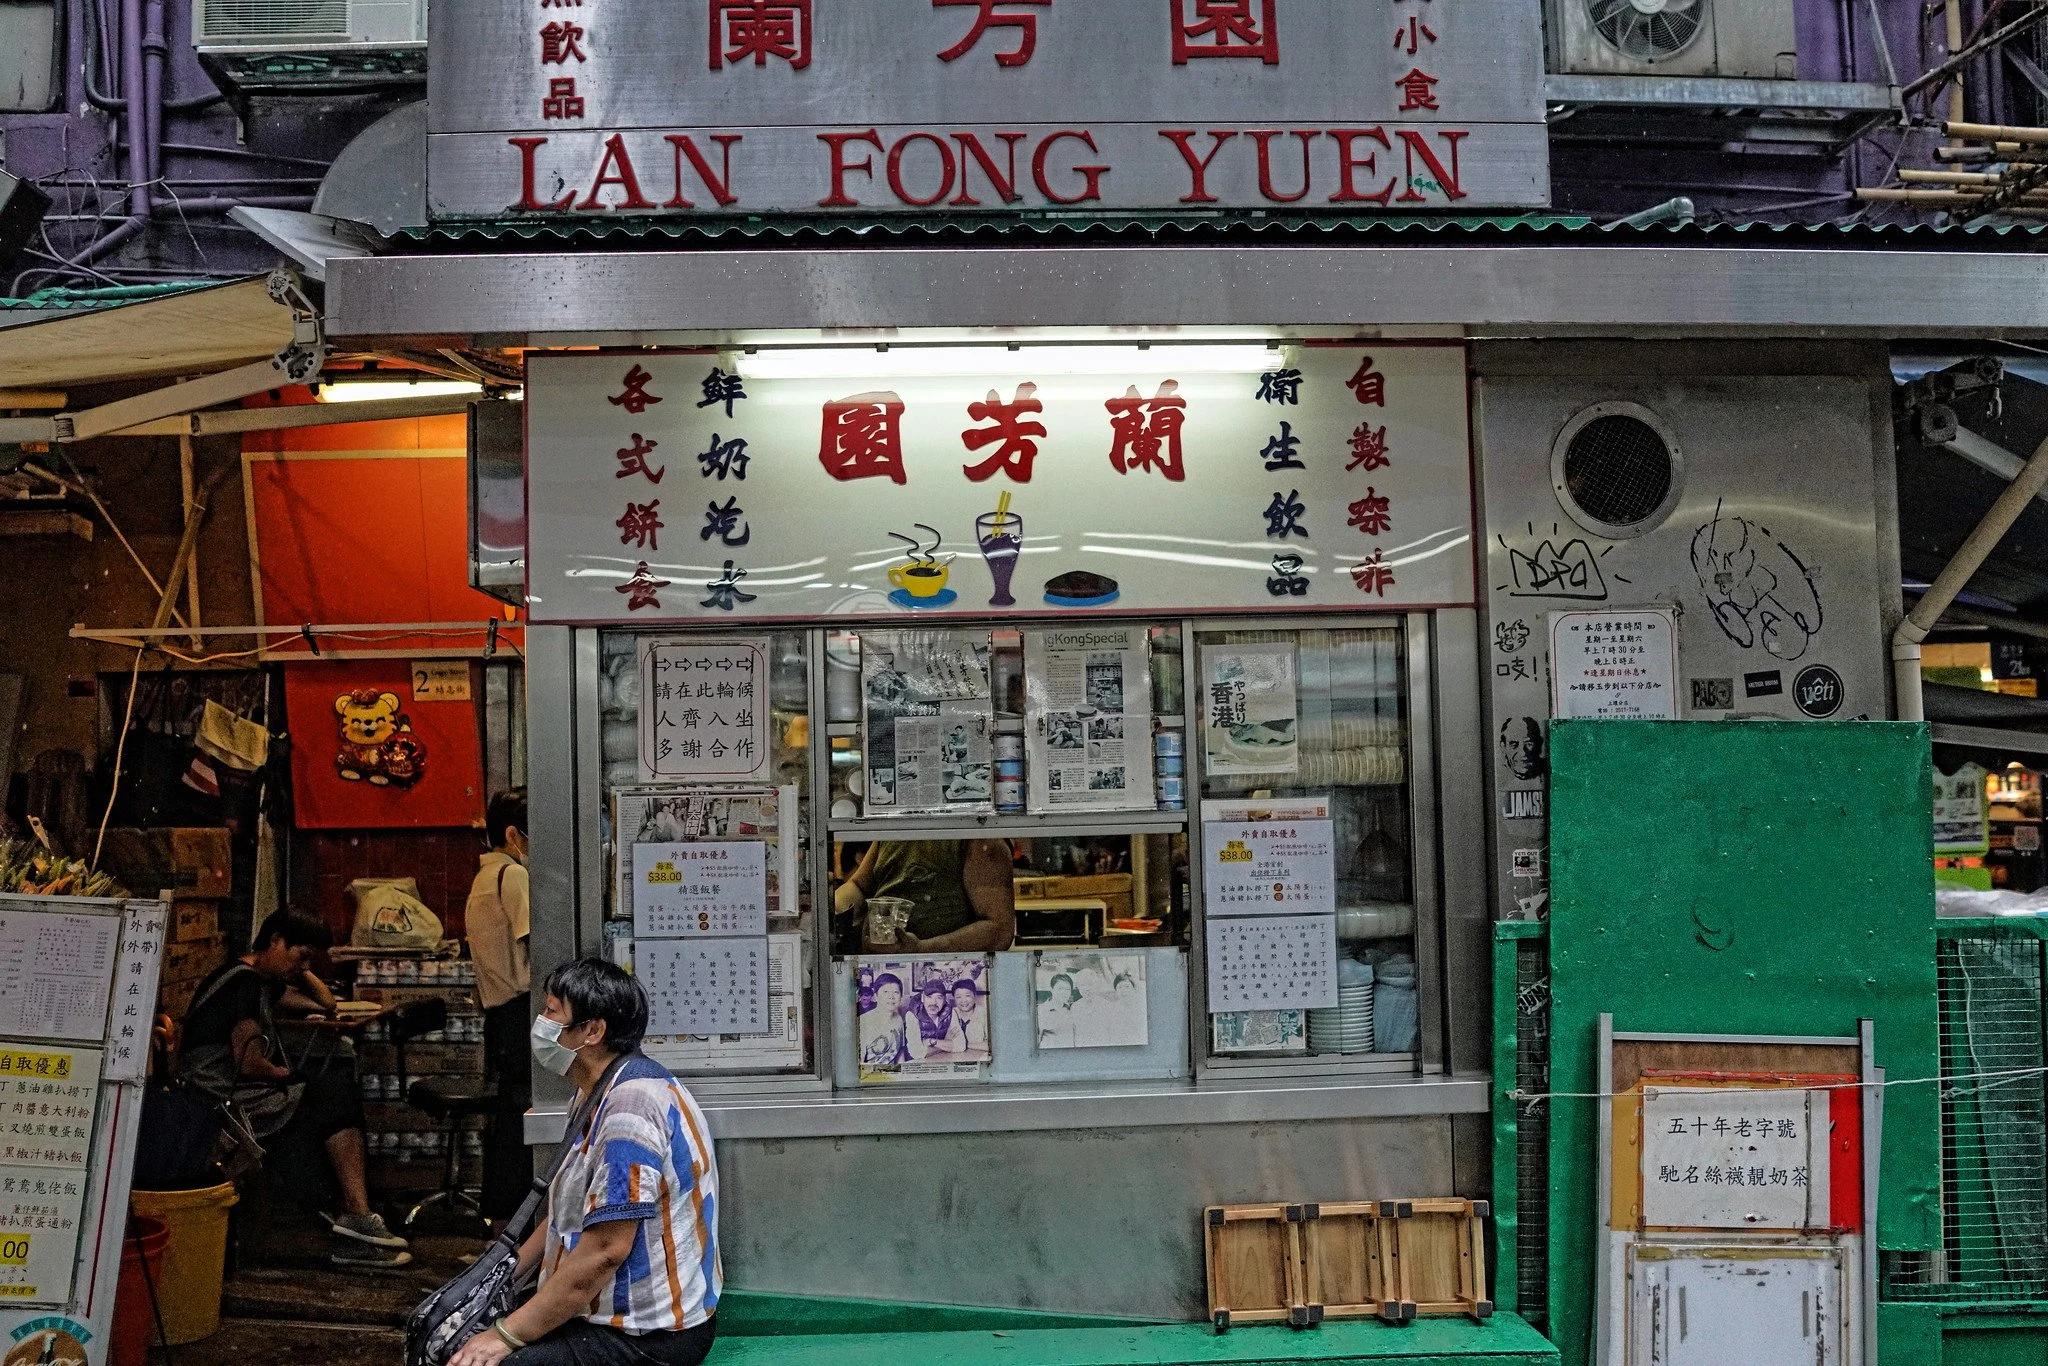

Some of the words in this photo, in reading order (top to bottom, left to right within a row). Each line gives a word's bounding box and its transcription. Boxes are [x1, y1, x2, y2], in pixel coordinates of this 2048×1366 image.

[539, 0, 587, 120] 飲品
[1393, 0, 1440, 112] 小食
[508, 134, 744, 212] LAN
[817, 127, 1111, 207] FONG
[1158, 125, 1469, 207] YUEN
[1585, 634, 1643, 643] 星期一至星期六
[415, 670, 430, 692] 2
[655, 682, 754, 699] 請在此輪候
[1211, 681, 1235, 729] 香港
[657, 707, 754, 729] 人齊入坐
[656, 738, 754, 760] 多謝合作
[1219, 850, 1253, 862] $38.00
[648, 872, 682, 883] $38.00
[118, 962, 144, 1060] 請在此輪候
[1, 1054, 69, 1076] 自取優惠
[1667, 1116, 1797, 1138] 五十年老字號
[1659, 1164, 1809, 1187] 馳名絲襪靚奶茶
